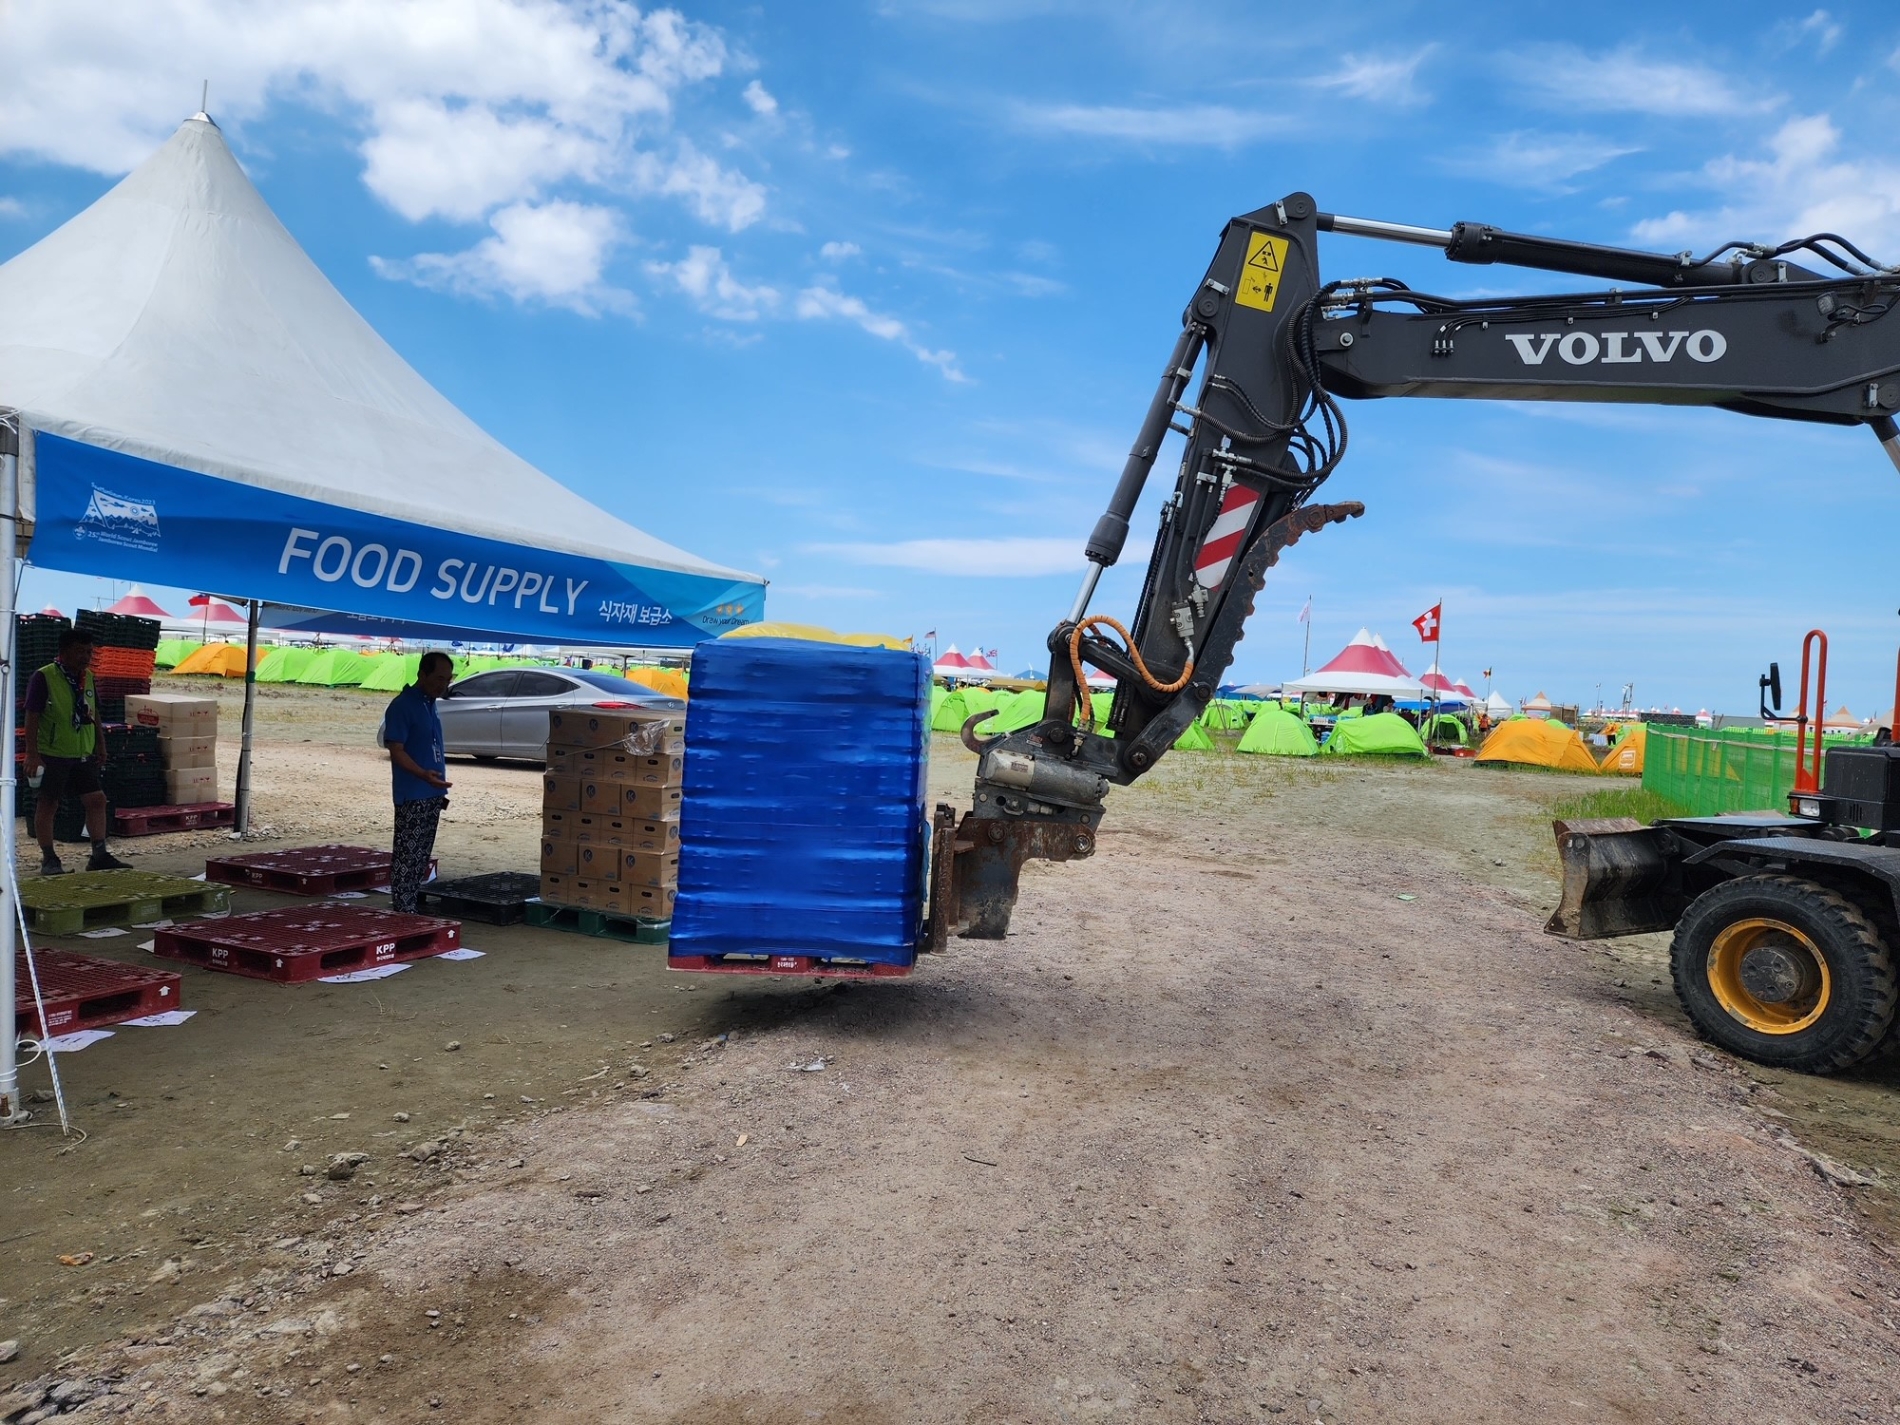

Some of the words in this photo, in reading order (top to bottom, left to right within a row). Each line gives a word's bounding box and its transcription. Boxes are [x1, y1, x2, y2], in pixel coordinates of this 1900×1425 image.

[1505, 329, 1727, 365] VOLVO
[278, 527, 423, 594] FOOD
[430, 558, 589, 616] SUPPLY
[598, 600, 637, 624] 식자재
[637, 605, 673, 626] 보급소
[702, 615, 719, 625] Draw
[212, 947, 229, 959] KPP
[376, 942, 396, 955] KPP
